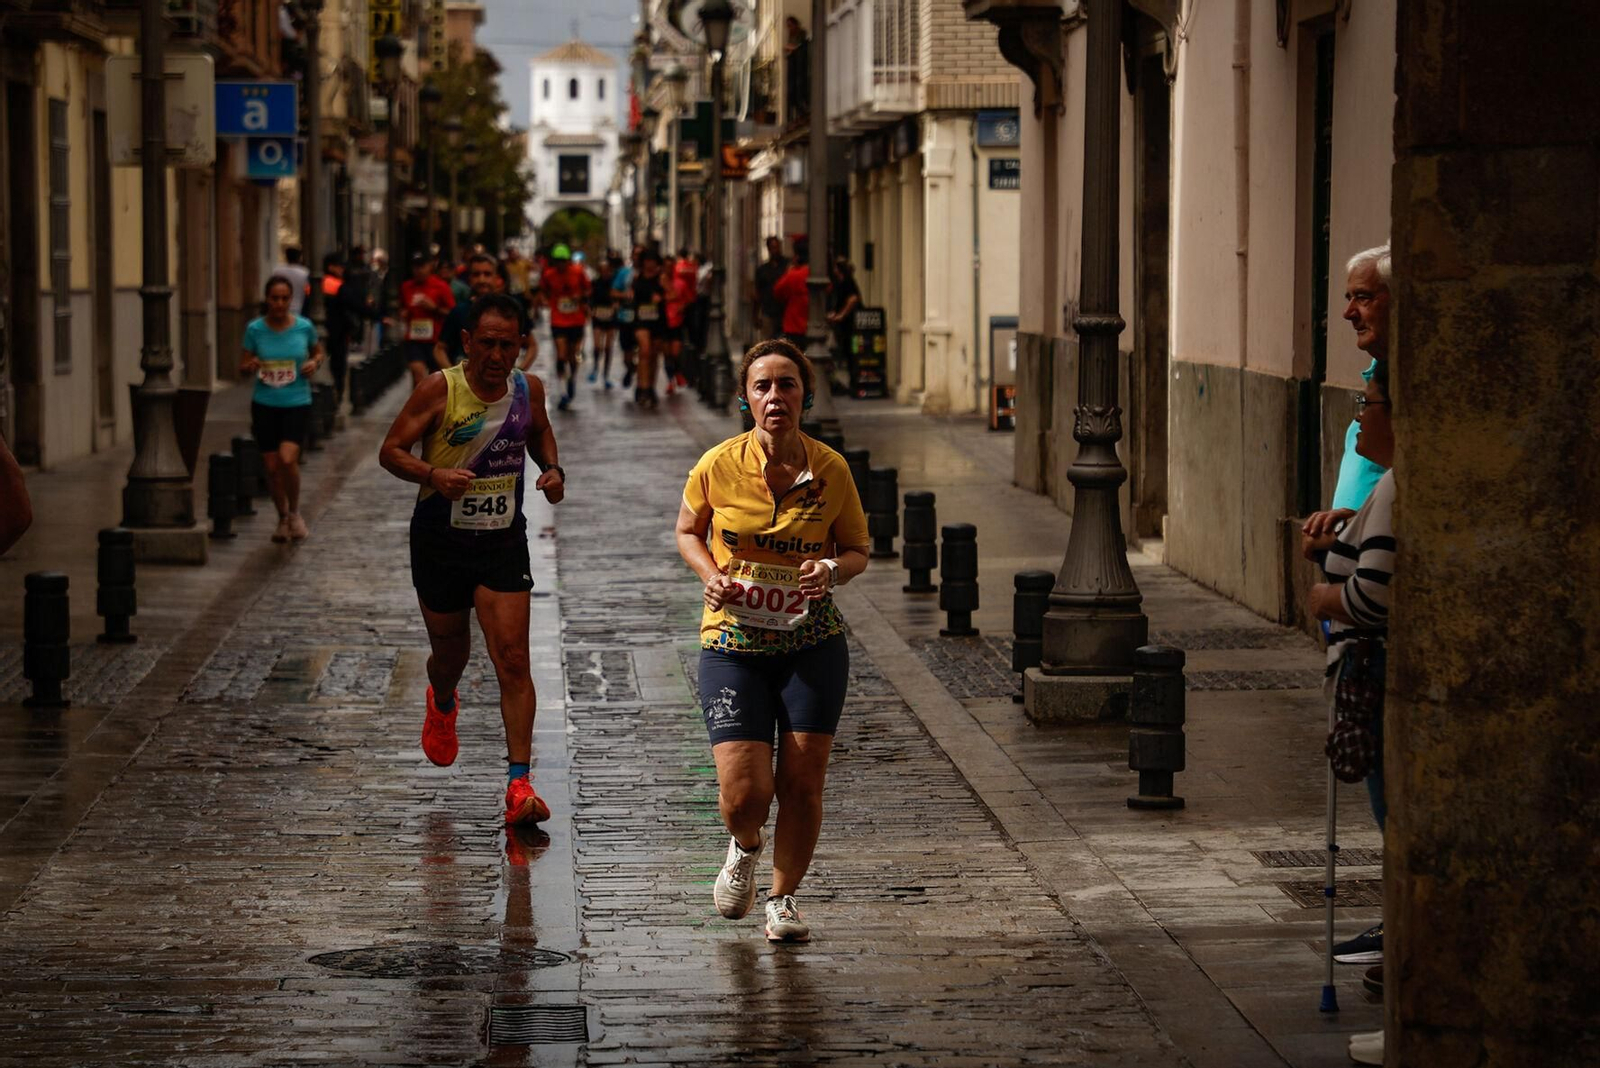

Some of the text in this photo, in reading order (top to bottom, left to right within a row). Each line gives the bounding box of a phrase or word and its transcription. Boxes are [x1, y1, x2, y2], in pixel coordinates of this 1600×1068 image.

[242, 98, 269, 131] a
[461, 495, 508, 516] 548
[753, 533, 823, 554] Vigilsa
[751, 569, 793, 582] FONDO
[725, 581, 805, 615] 2002
